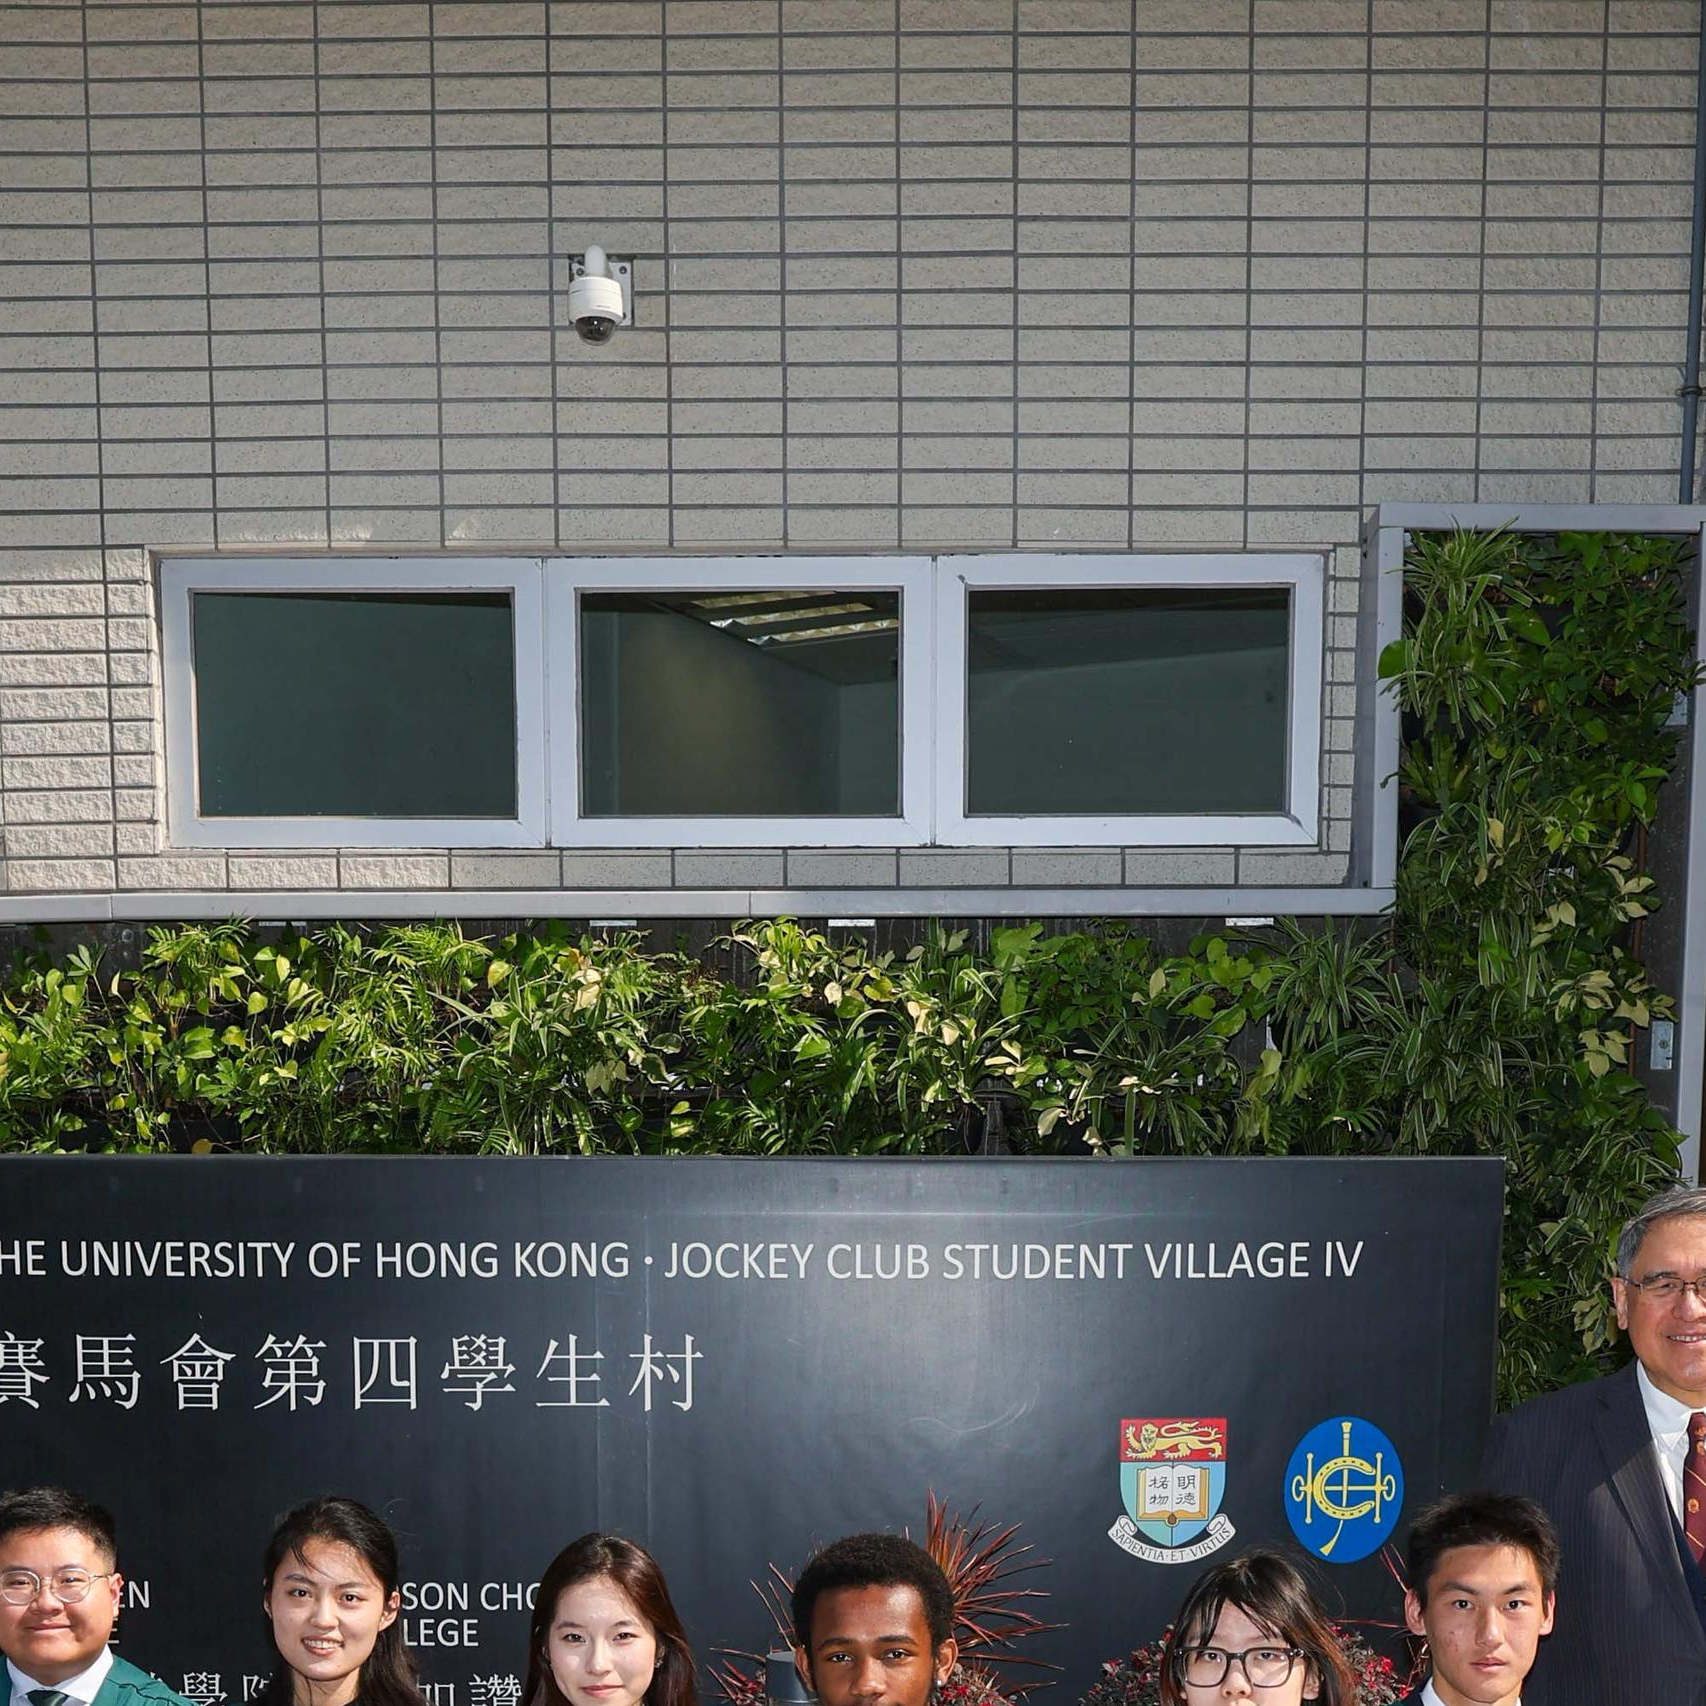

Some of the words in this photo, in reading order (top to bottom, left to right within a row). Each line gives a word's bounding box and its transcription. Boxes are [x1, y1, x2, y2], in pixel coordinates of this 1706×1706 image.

[62, 1241, 295, 1278] UNIVERSITY
[309, 1242, 360, 1278] OF
[377, 1242, 497, 1278] HONG
[515, 1242, 629, 1278] KONG
[665, 1243, 813, 1279] JOCKEY
[828, 1243, 928, 1279] CLUB
[944, 1243, 1133, 1279] STUDENT
[1145, 1241, 1309, 1279] VILLAGE
[1326, 1241, 1363, 1277] IV
[1189, 1527, 1231, 1558] VIRTUS
[402, 1582, 468, 1611] SON
[403, 1618, 479, 1647] LEGE
